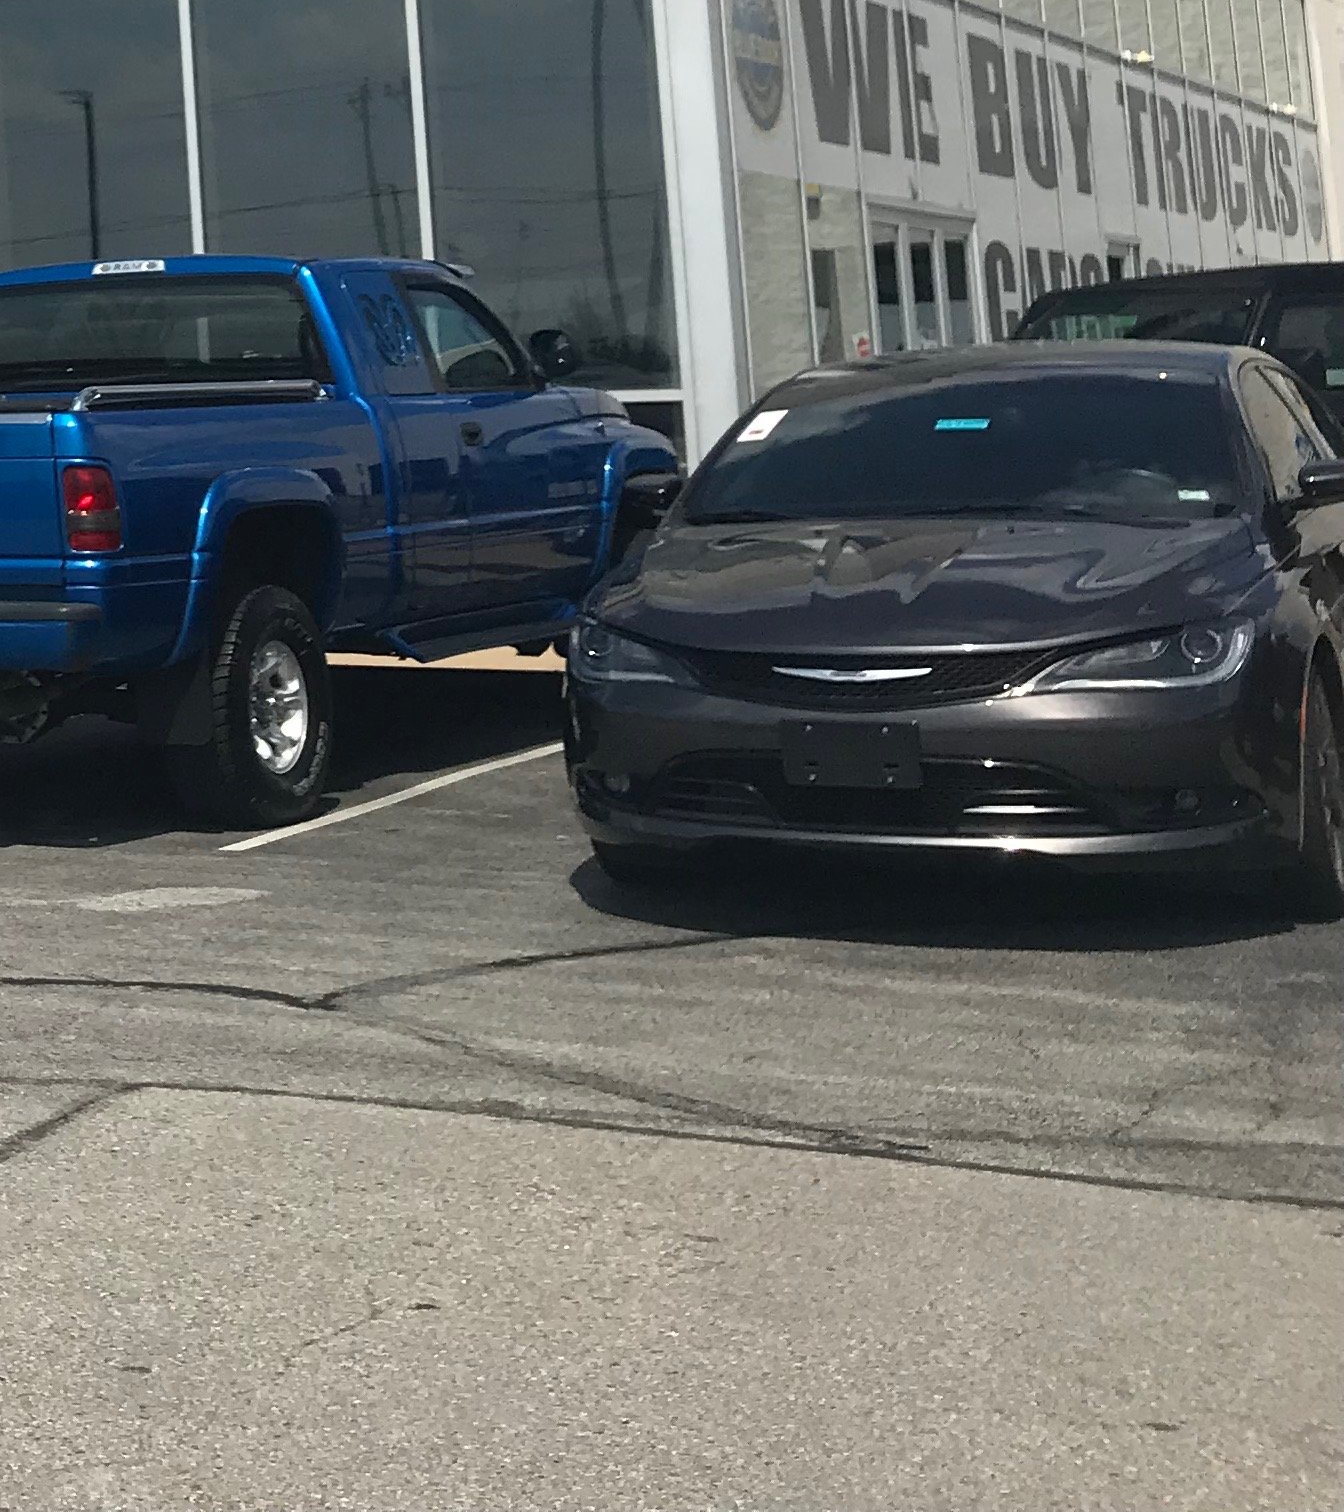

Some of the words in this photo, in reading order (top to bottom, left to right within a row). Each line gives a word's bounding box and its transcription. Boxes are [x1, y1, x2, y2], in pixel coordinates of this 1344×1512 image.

[967, 33, 1092, 193] BUY
[1116, 80, 1299, 236] TRUCKS
[113, 262, 142, 271] RAM
